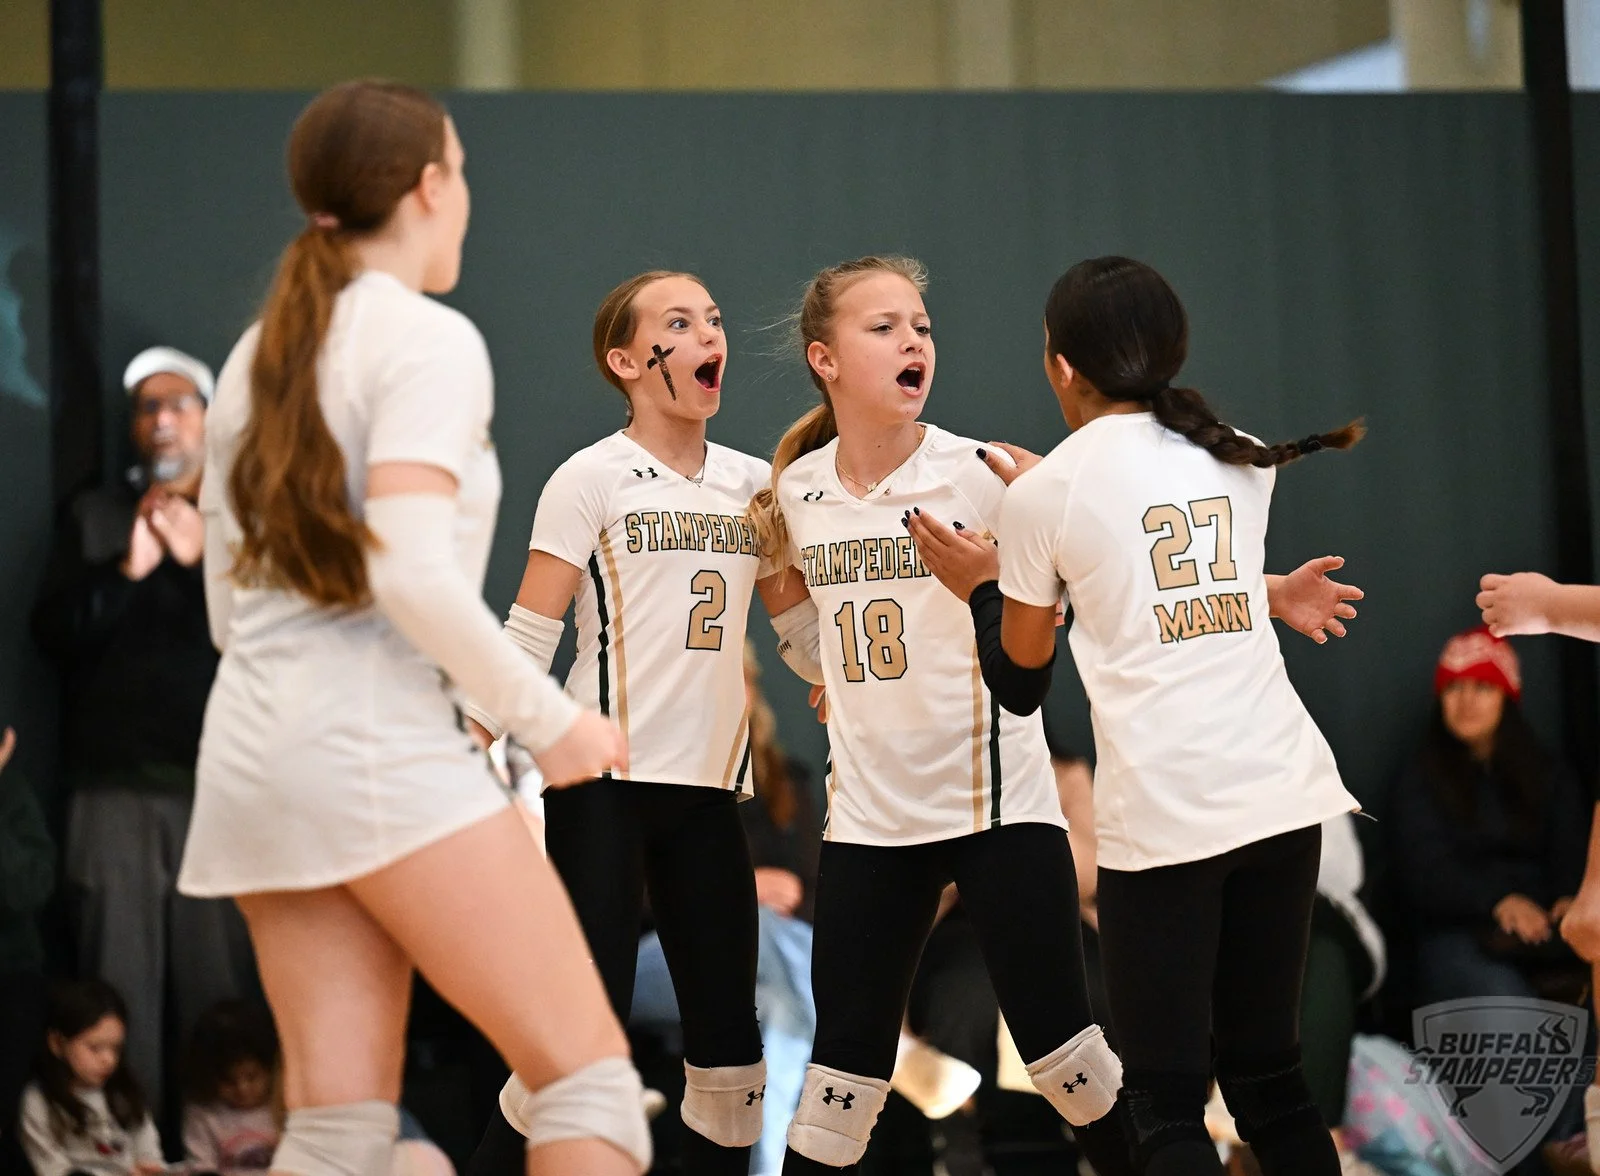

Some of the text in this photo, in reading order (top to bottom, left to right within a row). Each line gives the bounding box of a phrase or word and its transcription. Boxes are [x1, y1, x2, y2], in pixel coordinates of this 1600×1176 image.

[801, 536, 932, 587] TAMPEDE
[1142, 495, 1238, 591] 27
[685, 569, 727, 651] 2
[834, 598, 909, 682] 18
[1153, 592, 1253, 644] MANN
